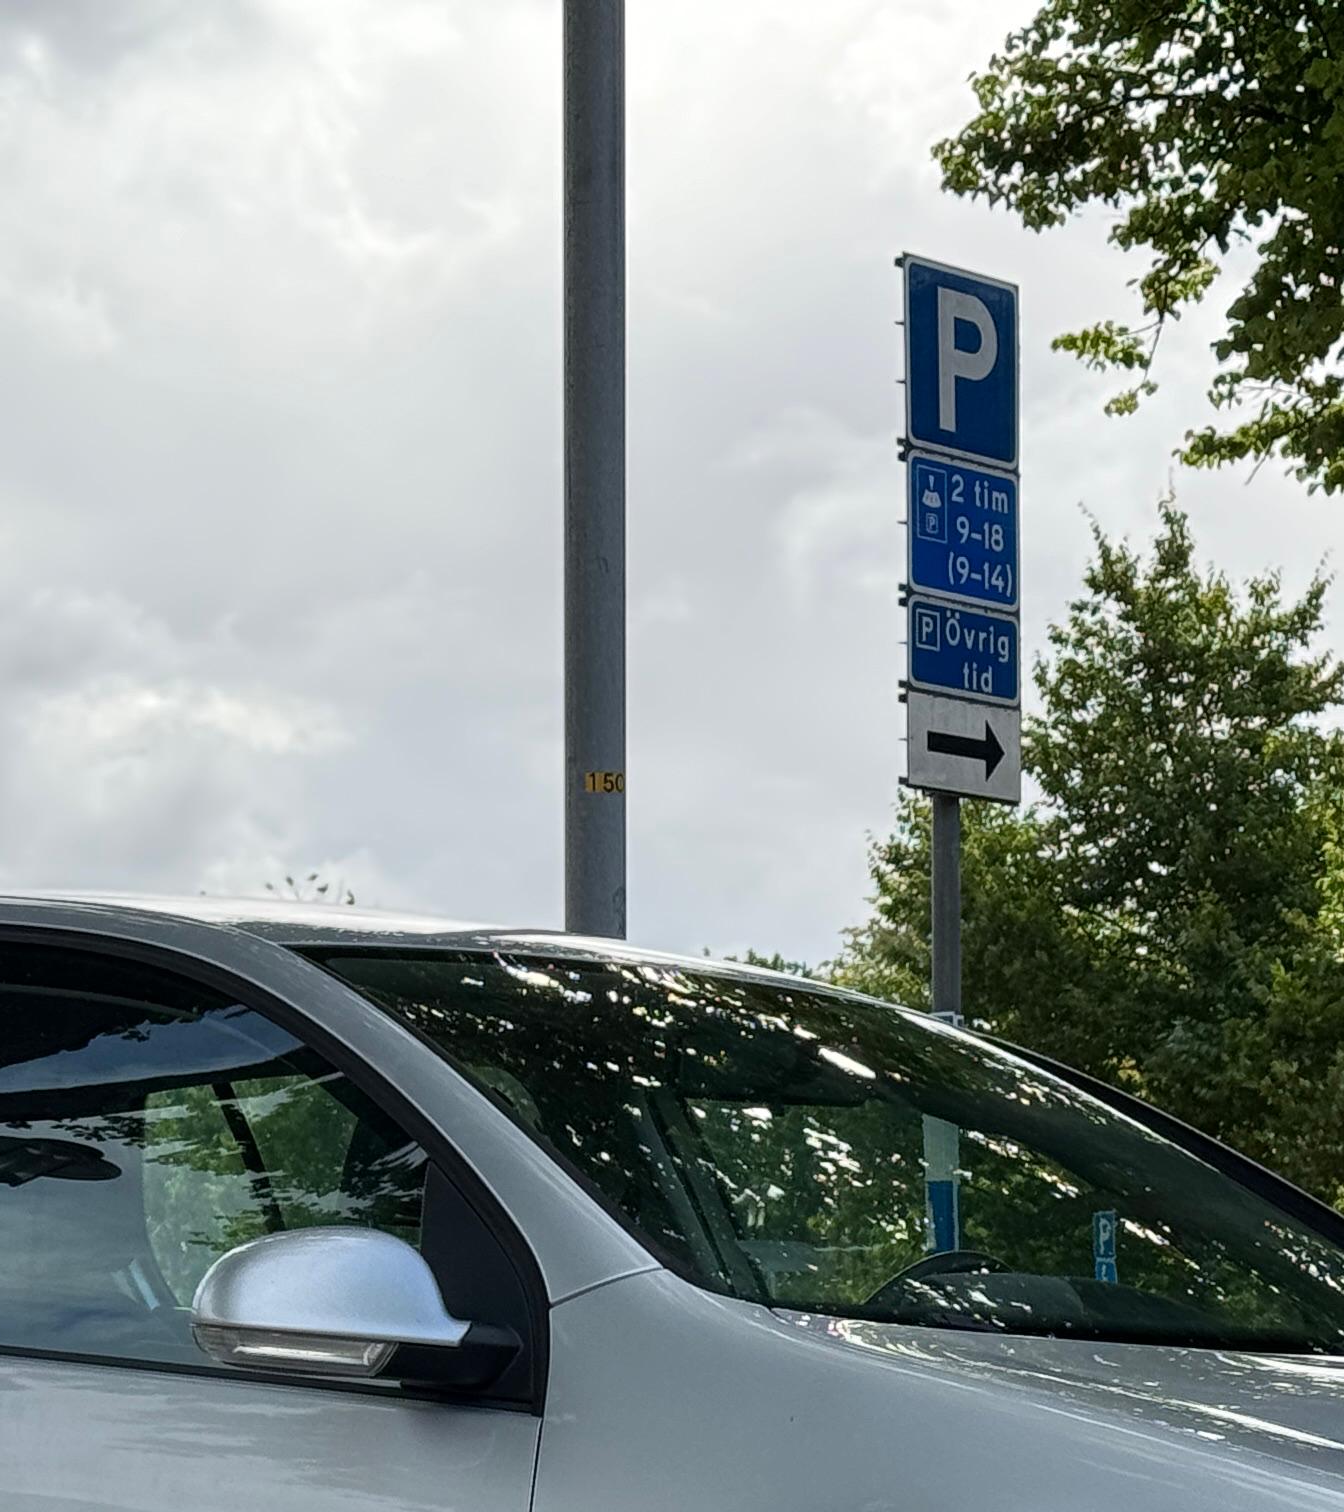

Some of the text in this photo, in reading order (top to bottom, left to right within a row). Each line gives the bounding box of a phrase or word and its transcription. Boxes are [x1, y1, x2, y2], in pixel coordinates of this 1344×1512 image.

[937, 286, 998, 433] P
[951, 474, 1008, 514] 2 tim
[956, 516, 1004, 552] 9-18
[948, 551, 1012, 597] (9-14)
[921, 609, 1009, 663] P Övrig
[963, 662, 993, 693] tid
[589, 772, 625, 793] 150
